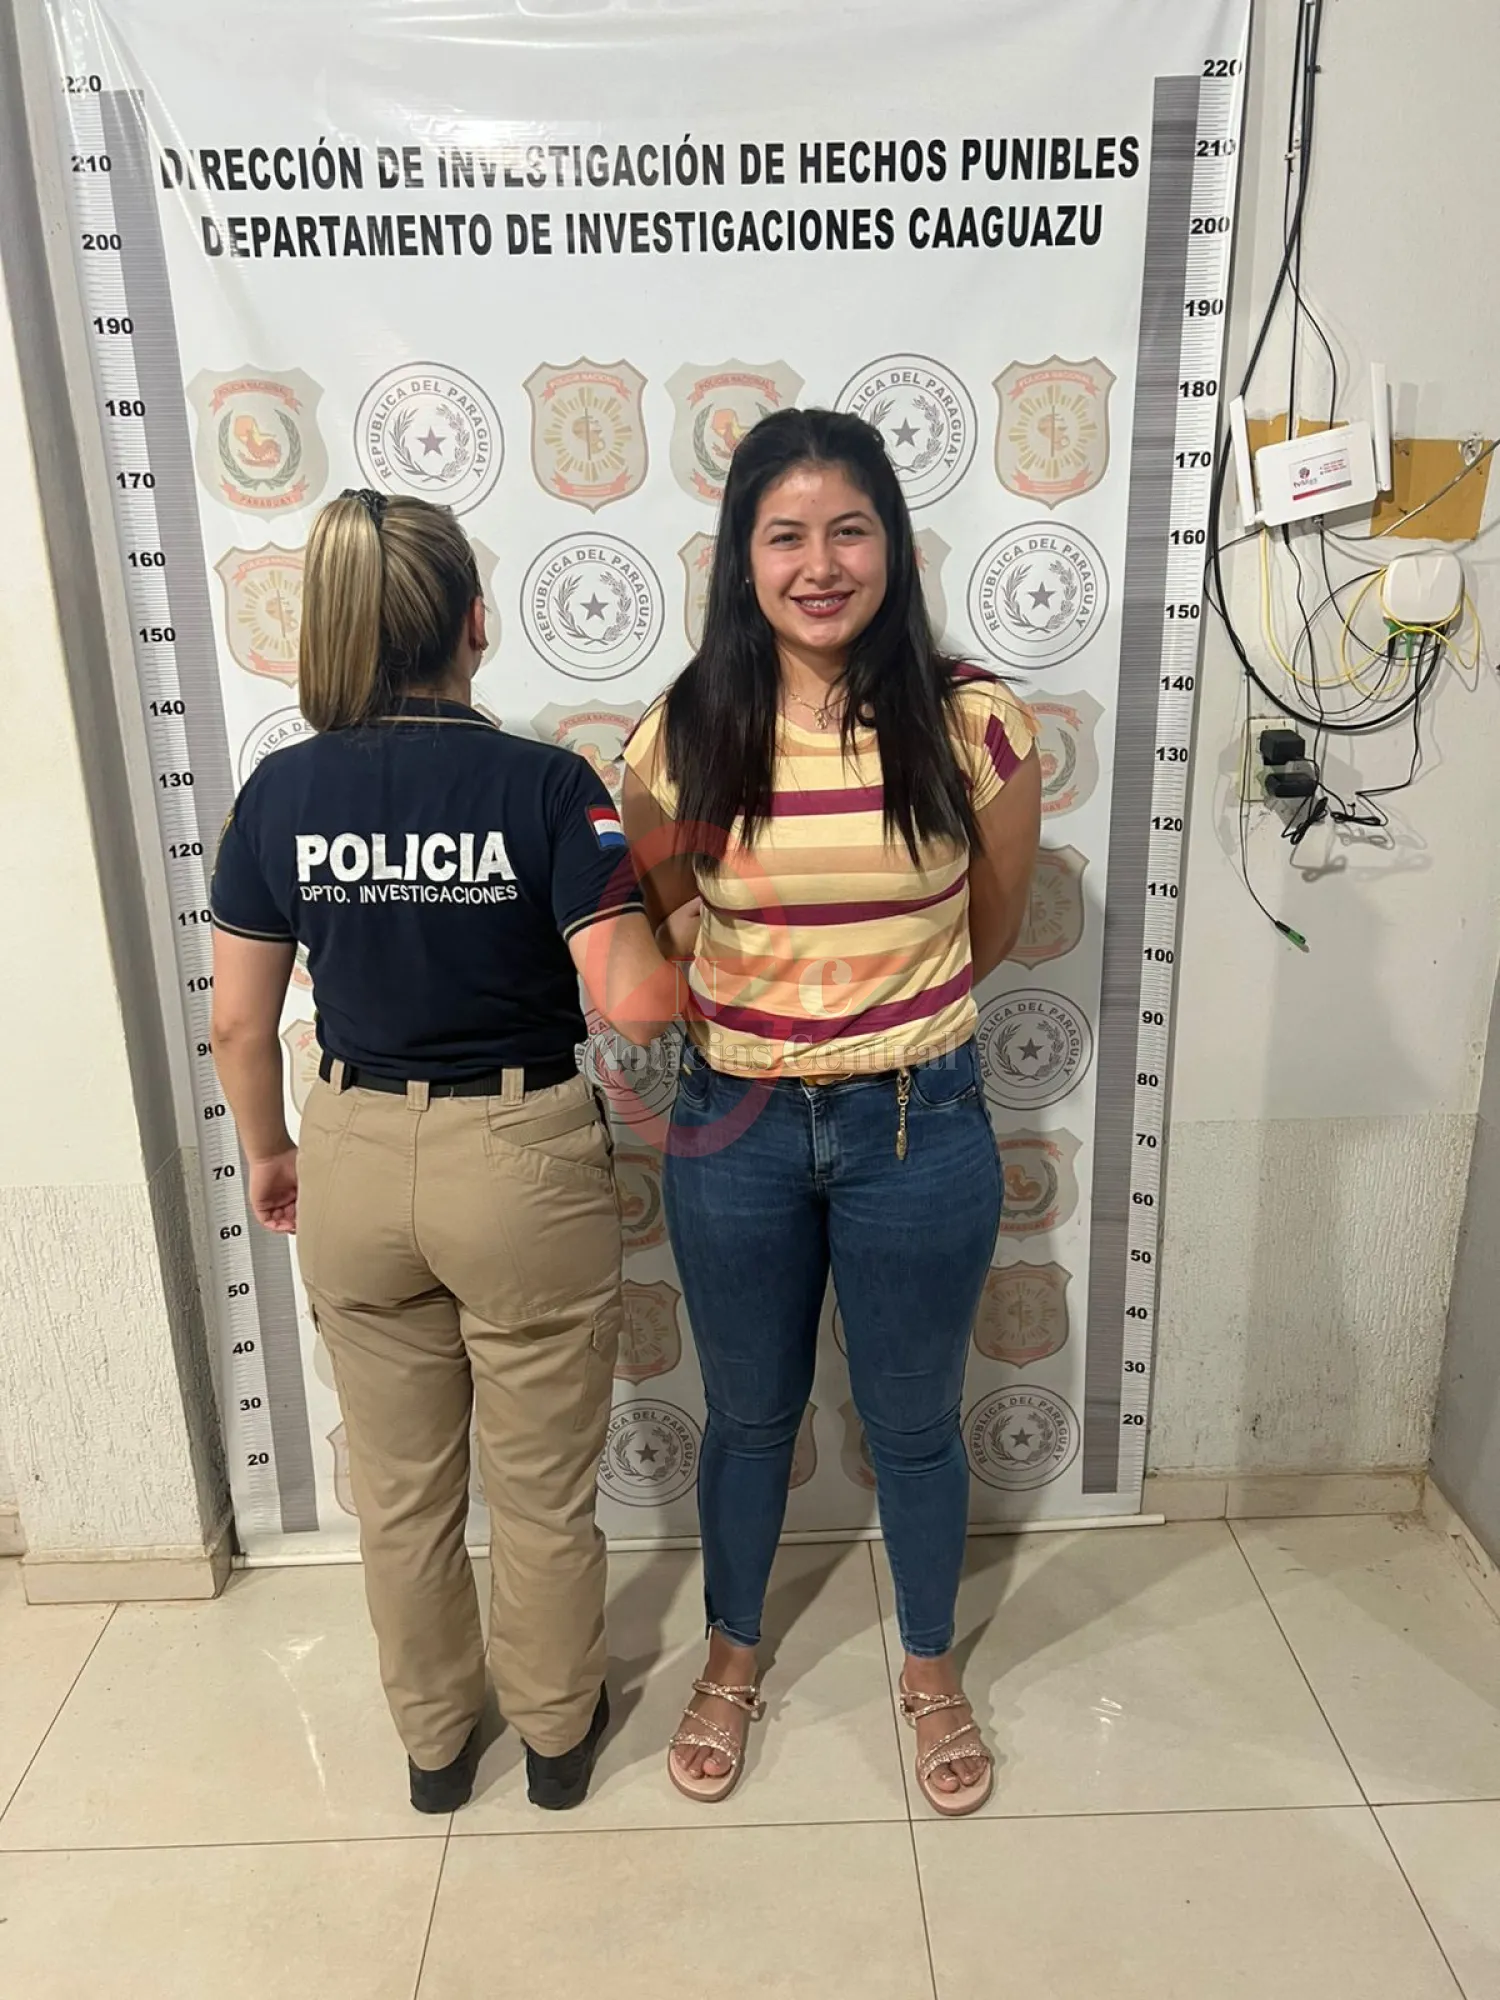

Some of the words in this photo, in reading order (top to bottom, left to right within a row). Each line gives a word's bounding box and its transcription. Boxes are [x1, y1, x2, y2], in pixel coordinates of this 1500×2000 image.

[1202, 58, 1243, 77] 220
[60, 74, 103, 94] 220
[1195, 138, 1237, 158] 210
[71, 155, 112, 172] 210
[160, 136, 363, 191] DIRECCIÓN
[377, 146, 424, 189] DE
[437, 132, 724, 190] INVESTIGACIÓN
[740, 143, 785, 185] DE
[799, 139, 947, 184] HECHOS
[961, 136, 1139, 181] PUNIBLES
[201, 213, 492, 258] DEPARTAMENTO
[506, 213, 552, 255] DE
[565, 208, 895, 254] INVESTIGACIONES
[909, 204, 1102, 249] CAAGUAZU
[1190, 217, 1230, 235] 200
[81, 234, 122, 251] 200
[1185, 299, 1223, 317] 190
[93, 317, 134, 335] 190
[1179, 380, 1217, 398] 180
[105, 400, 146, 417] 180
[891, 371, 921, 384] DEL
[926, 378, 962, 468] PARAGUAY
[370, 387, 407, 479] REPUBLICA
[411, 379, 441, 393] DEL
[448, 387, 489, 478] PARAGUAY
[1174, 451, 1212, 468] 170
[116, 472, 156, 489] 170
[1170, 529, 1206, 545] 160
[128, 552, 166, 568] 160
[983, 545, 1024, 631] REPUBLICA
[1029, 538, 1057, 550] DEL
[1062, 544, 1094, 628] PARAGUAY
[536, 555, 572, 641] REPUBLICA
[576, 549, 606, 561] DEL
[611, 555, 649, 640] PARAGUAY
[1166, 604, 1200, 619] 150
[139, 627, 176, 643] 150
[1161, 675, 1194, 691] 140
[149, 700, 186, 717] 140
[1156, 747, 1188, 763] 130
[159, 772, 195, 789] 130
[1152, 816, 1183, 832] 120
[168, 842, 204, 859] 120
[295, 831, 518, 883] POLICIA
[302, 885, 350, 903] DPTO.
[360, 884, 518, 905] INVESTIGACIONES
[1147, 882, 1179, 899] 110
[178, 909, 212, 927] 110
[1144, 947, 1175, 964] 100
[1142, 1010, 1164, 1026] 90
[1018, 1002, 1044, 1012] DEL
[1049, 1008, 1079, 1076] PARAGUAY
[196, 1043, 213, 1057] 9
[1136, 1072, 1159, 1088] 80
[203, 1104, 226, 1120] 80
[1136, 1133, 1157, 1148] 70
[212, 1164, 235, 1181] 70
[1132, 1192, 1154, 1207] 60
[219, 1224, 242, 1240] 60
[1130, 1249, 1152, 1264] 50
[227, 1282, 250, 1298] 50
[1125, 1306, 1148, 1320] 40
[232, 1340, 255, 1355] 40
[1124, 1360, 1146, 1374] 30
[240, 1397, 262, 1411] 30
[1122, 1413, 1144, 1426] 20
[1010, 1397, 1033, 1406] DEL
[1038, 1401, 1068, 1460] PARAGUAY
[633, 1411, 657, 1420] DEL
[663, 1415, 693, 1476] PARAGUAY
[248, 1452, 270, 1466] 20
